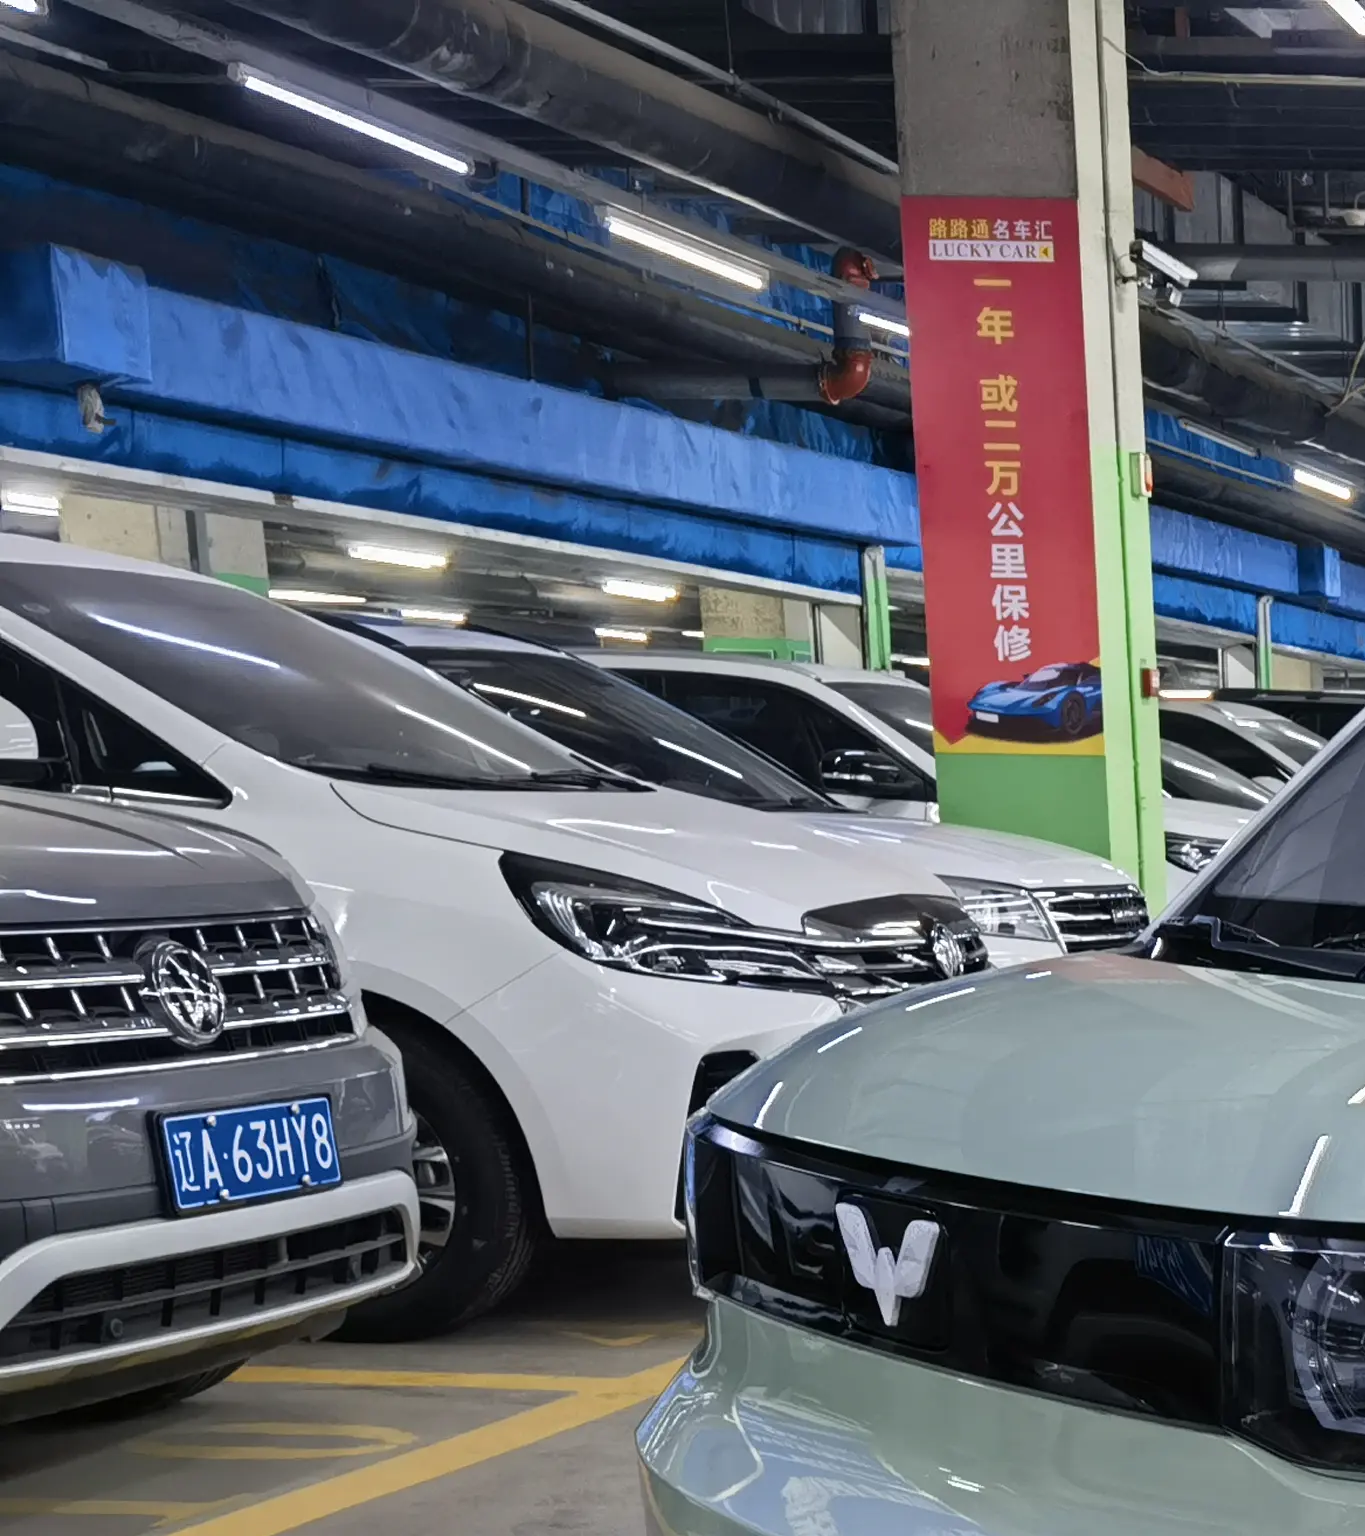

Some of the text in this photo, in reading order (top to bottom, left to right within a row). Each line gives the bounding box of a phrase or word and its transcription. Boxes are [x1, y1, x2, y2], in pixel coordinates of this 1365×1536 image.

[929, 217, 1053, 240] 路路通名车汇
[931, 241, 1037, 259] LUCKY CAR
